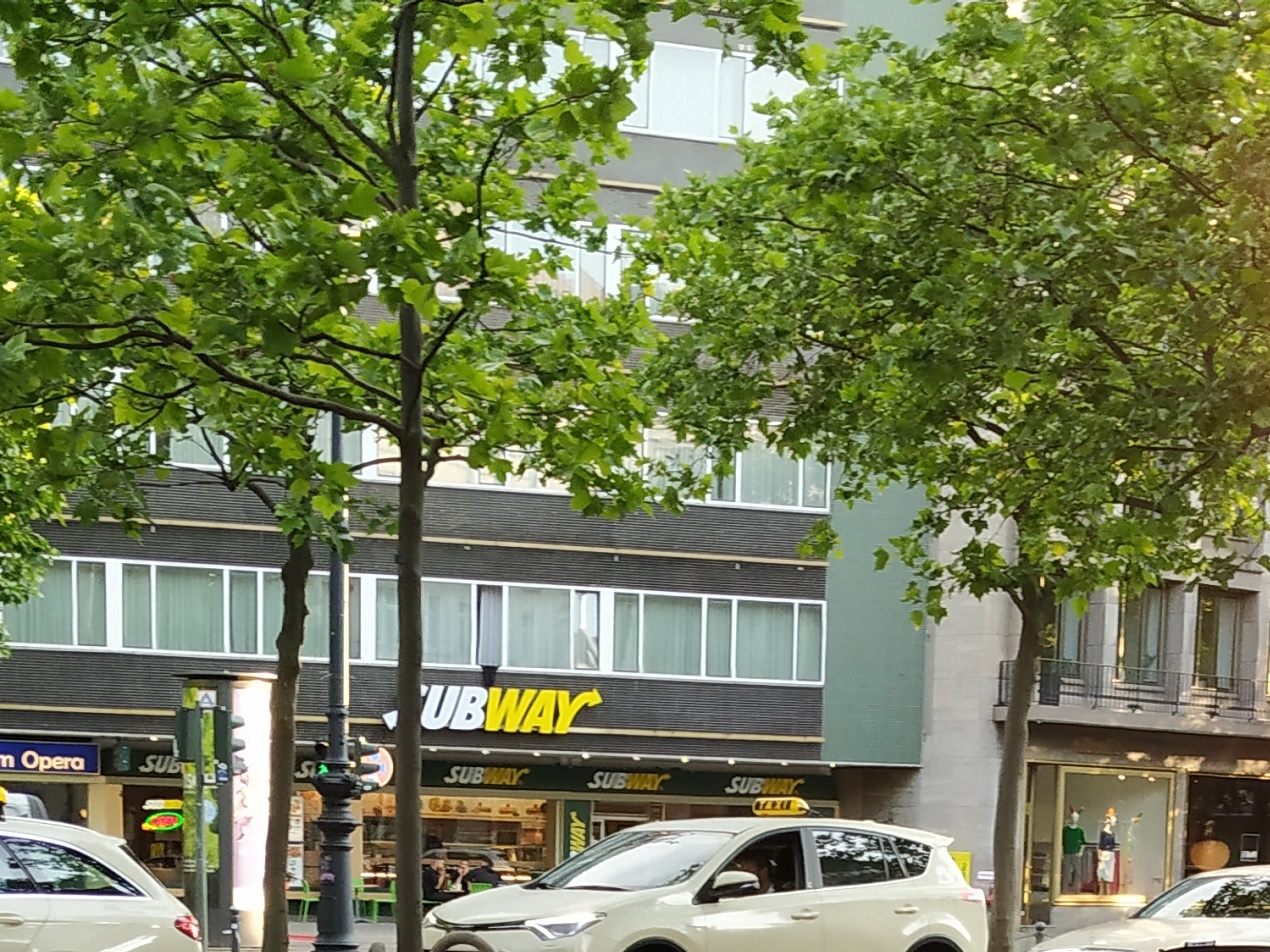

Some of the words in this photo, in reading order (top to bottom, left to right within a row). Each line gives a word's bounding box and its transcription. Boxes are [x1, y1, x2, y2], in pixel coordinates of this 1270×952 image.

[21, 750, 85, 772] Opera
[138, 754, 182, 774] SUB
[443, 765, 531, 786] SUBWAY
[587, 771, 672, 791] SUBWAY
[724, 776, 806, 795] SUBWAY
